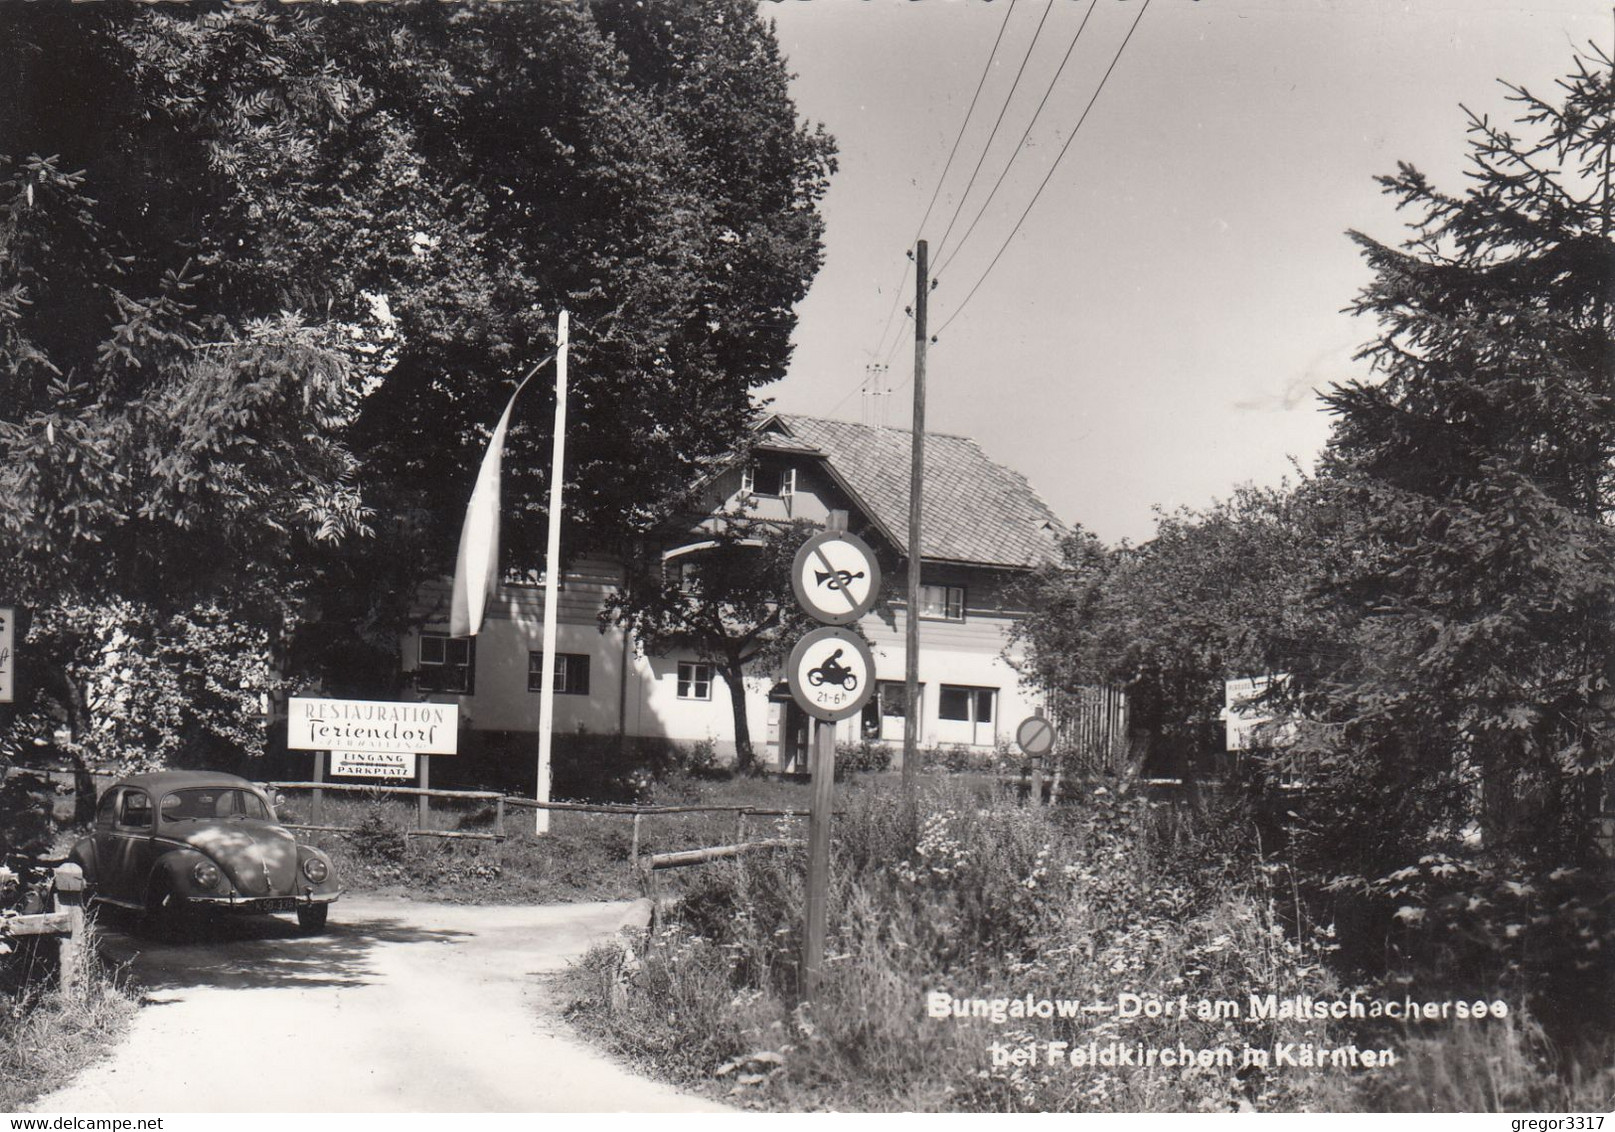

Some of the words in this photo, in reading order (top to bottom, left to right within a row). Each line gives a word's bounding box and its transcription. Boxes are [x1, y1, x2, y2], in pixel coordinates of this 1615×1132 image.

[305, 703, 444, 724] RESTAURATION
[344, 753, 403, 762] EINGANG
[337, 766, 408, 776] PARKPLATZ
